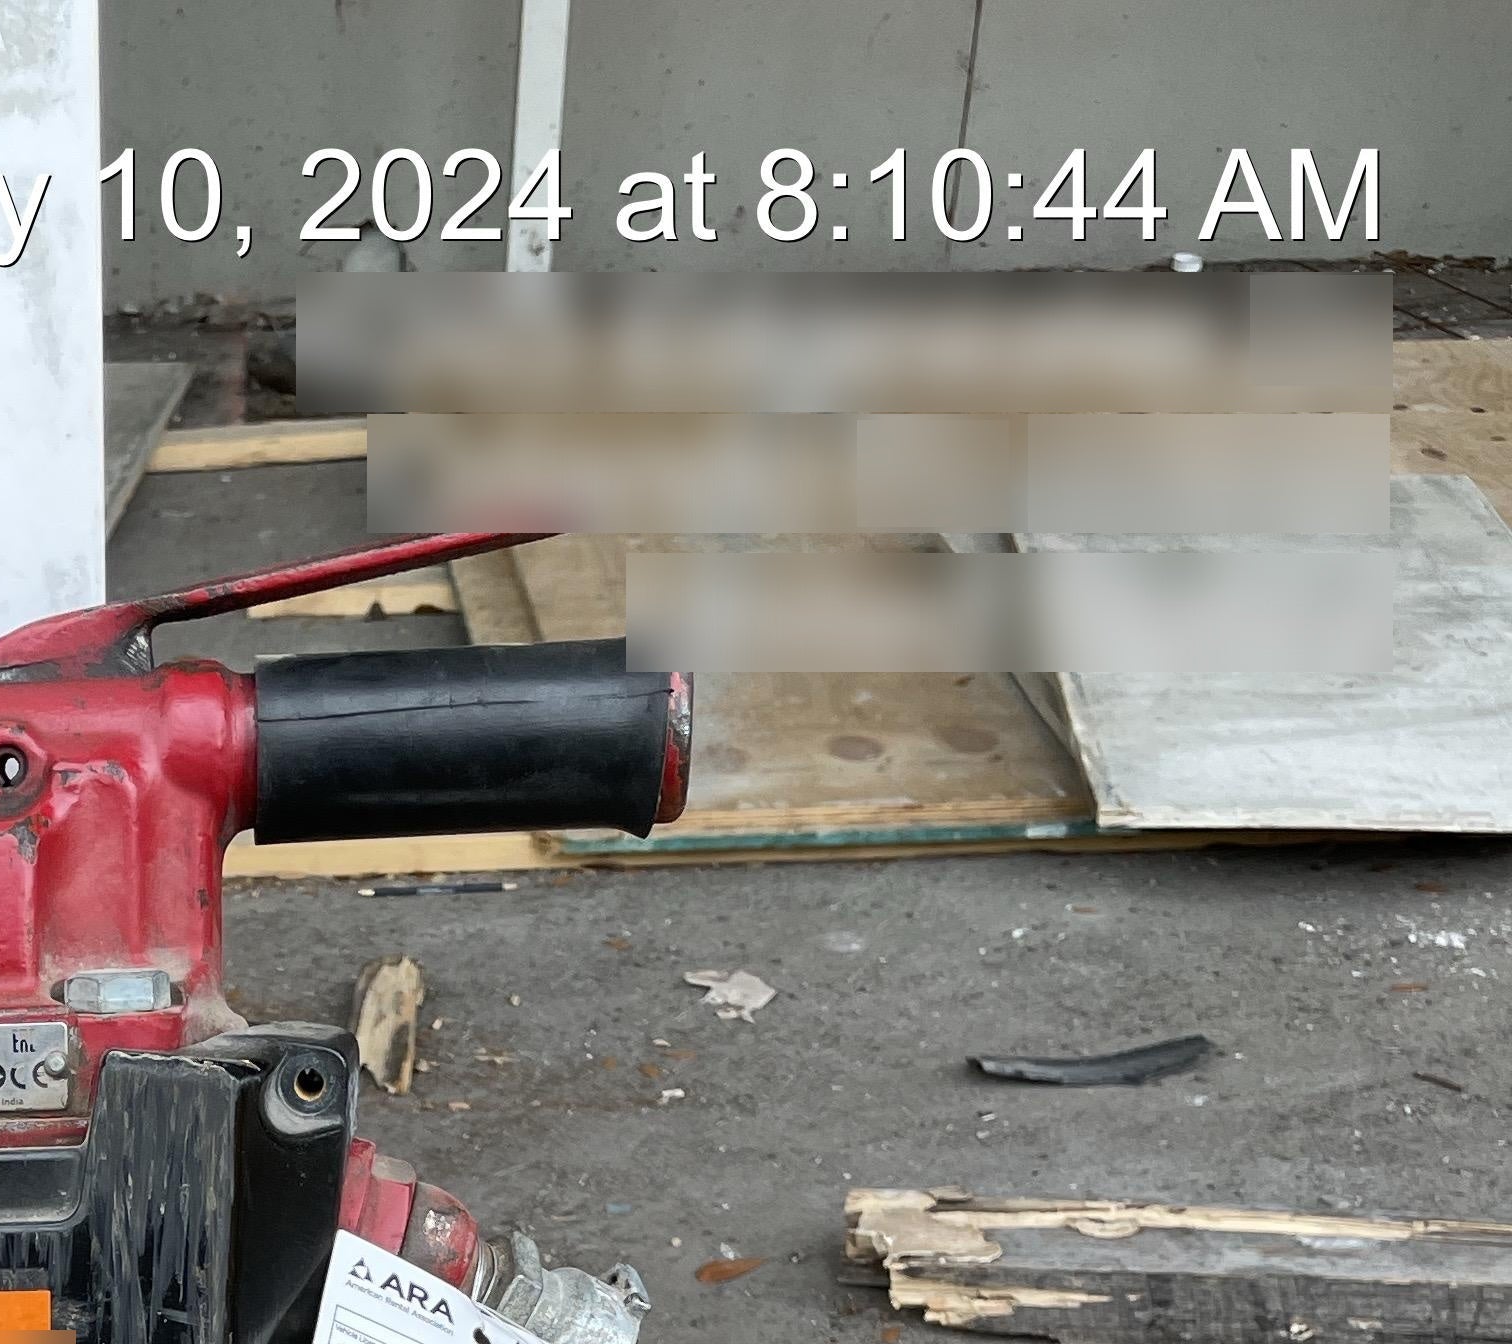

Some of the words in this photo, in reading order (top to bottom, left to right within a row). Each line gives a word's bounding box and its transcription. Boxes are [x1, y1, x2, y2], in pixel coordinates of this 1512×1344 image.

[1, 1097, 24, 1106] India
[344, 1279, 384, 1305] American
[410, 1308, 455, 1336] Association
[380, 1272, 454, 1325] ARA
